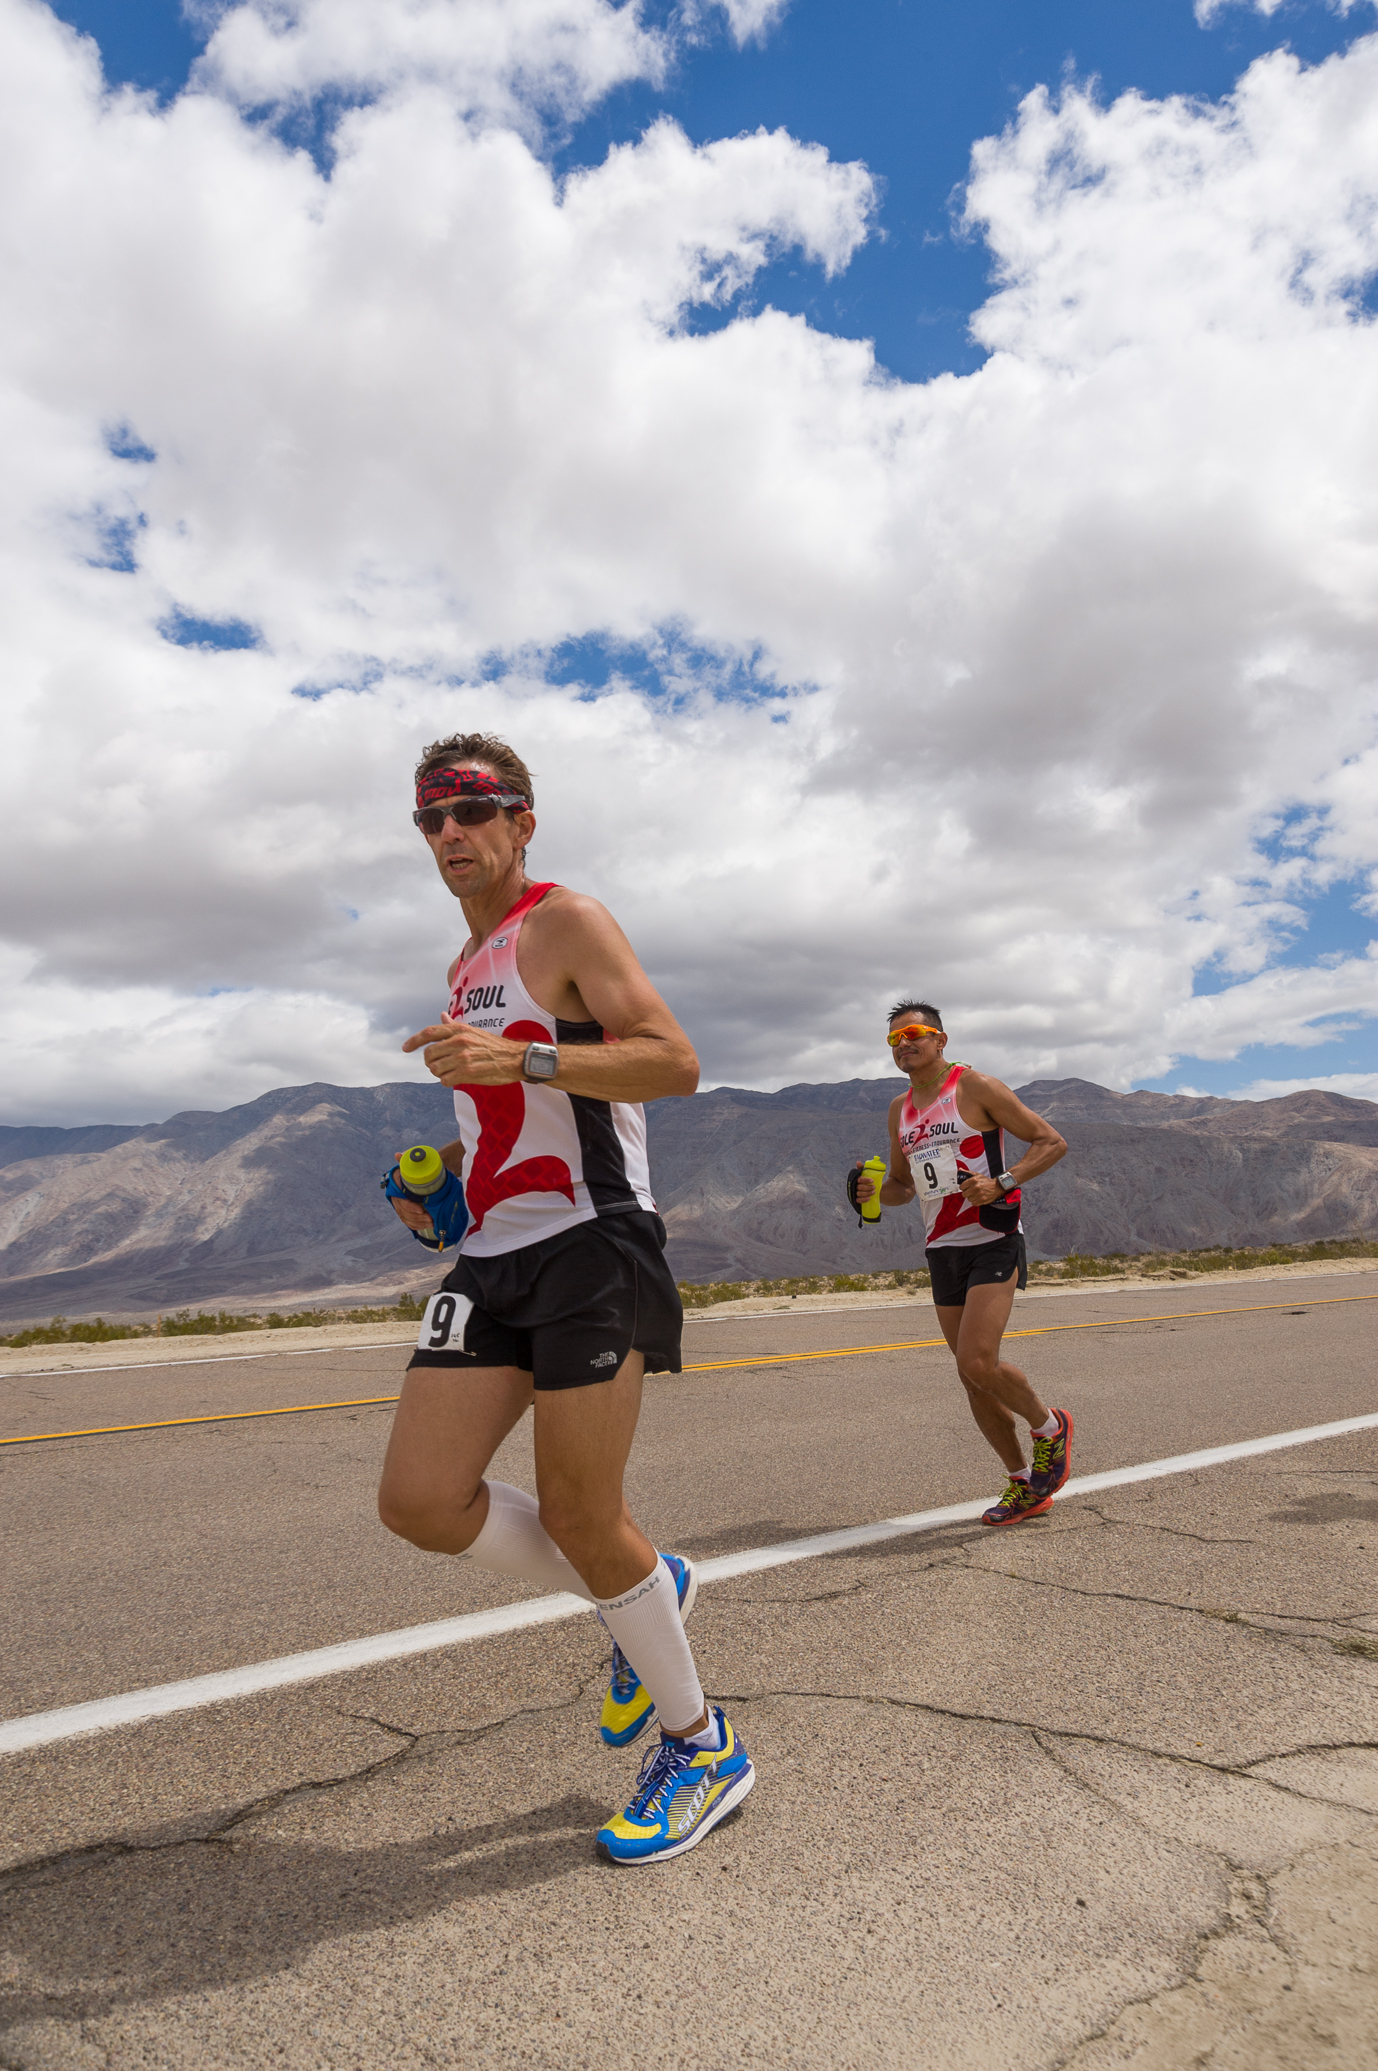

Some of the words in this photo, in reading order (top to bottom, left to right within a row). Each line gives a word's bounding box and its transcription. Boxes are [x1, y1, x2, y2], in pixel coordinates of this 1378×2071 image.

[464, 985, 506, 1014] SOUL
[929, 1122, 959, 1137] SOUL
[924, 1162, 938, 1189] 9
[428, 1295, 456, 1348] 9
[594, 1576, 660, 1611] ENSAH
[677, 1753, 717, 1837] SCOTT
